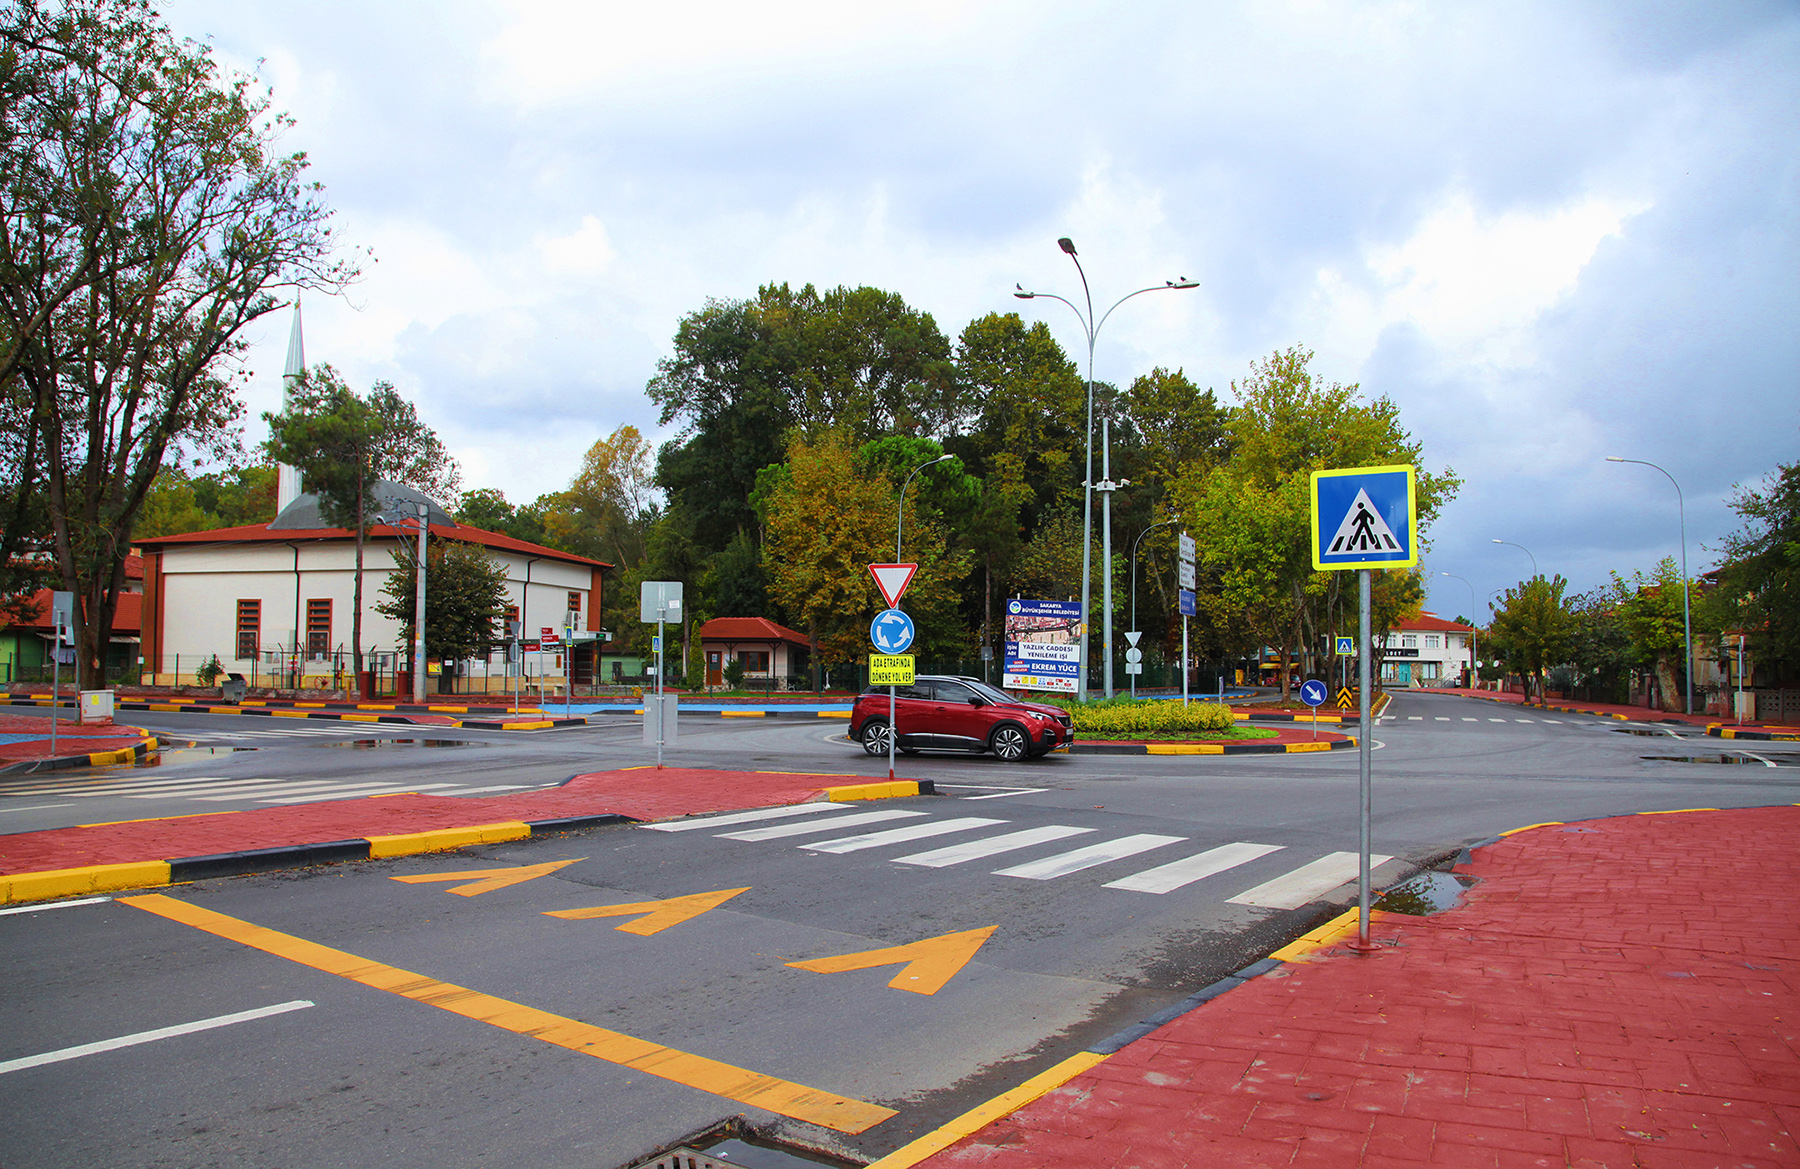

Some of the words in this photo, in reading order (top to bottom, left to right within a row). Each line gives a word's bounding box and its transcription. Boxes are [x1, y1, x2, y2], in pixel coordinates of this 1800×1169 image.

[873, 658, 882, 667] ADA
[884, 658, 910, 668] ETRAFINDA
[1058, 664, 1077, 672] YÜCE
[872, 669, 891, 681] DÖNENE
[892, 672, 901, 681] YOL
[902, 672, 911, 681] VER
